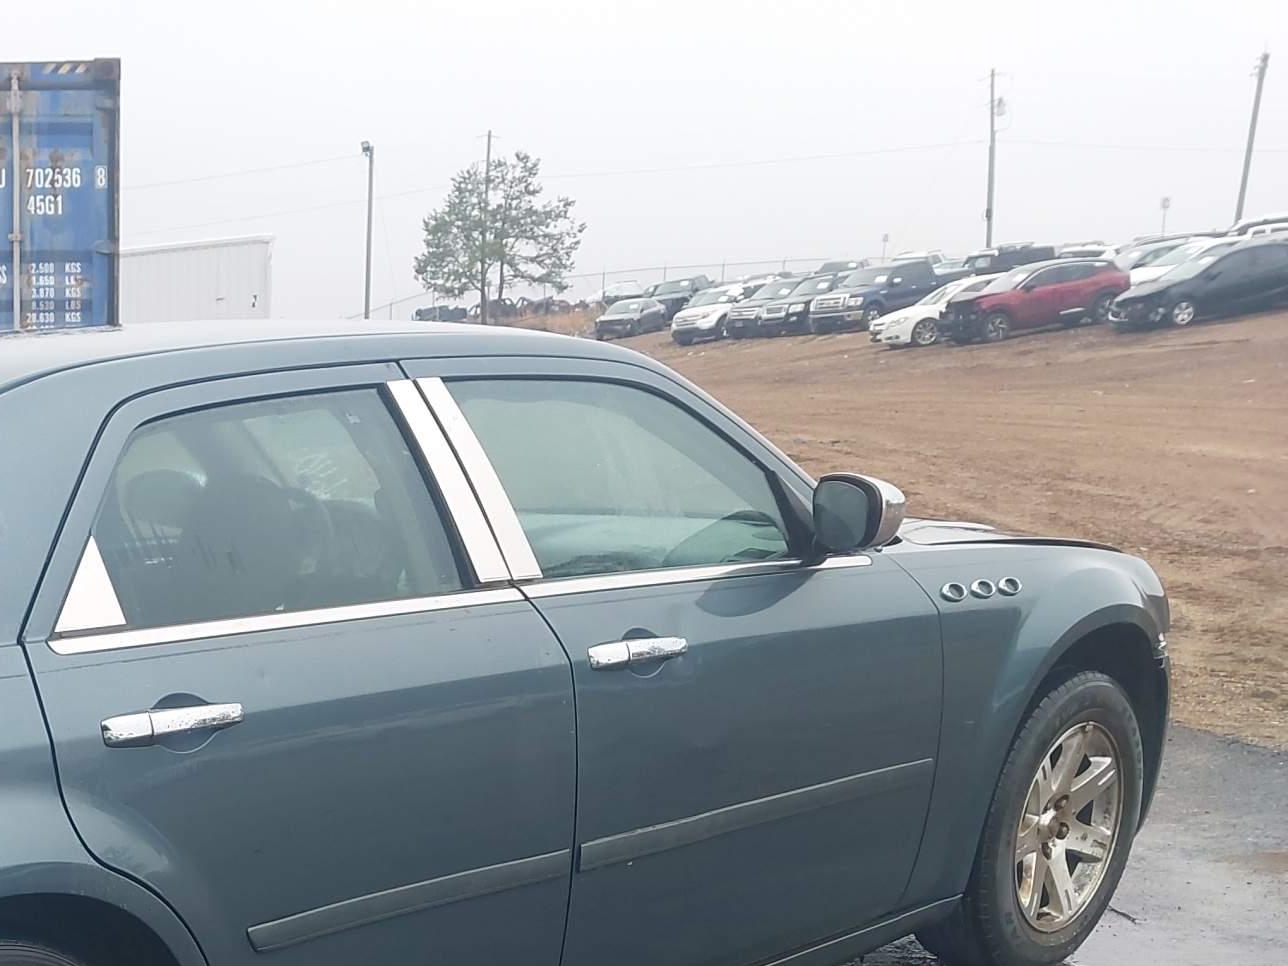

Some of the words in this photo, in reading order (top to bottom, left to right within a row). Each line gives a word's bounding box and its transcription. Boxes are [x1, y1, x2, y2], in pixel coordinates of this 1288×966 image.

[25, 167, 81, 189] 702536
[97, 166, 107, 188] 8
[27, 195, 63, 215] 45G1
[65, 262, 82, 274] KGS
[65, 287, 81, 298] KGS
[65, 312, 81, 323] KGS
